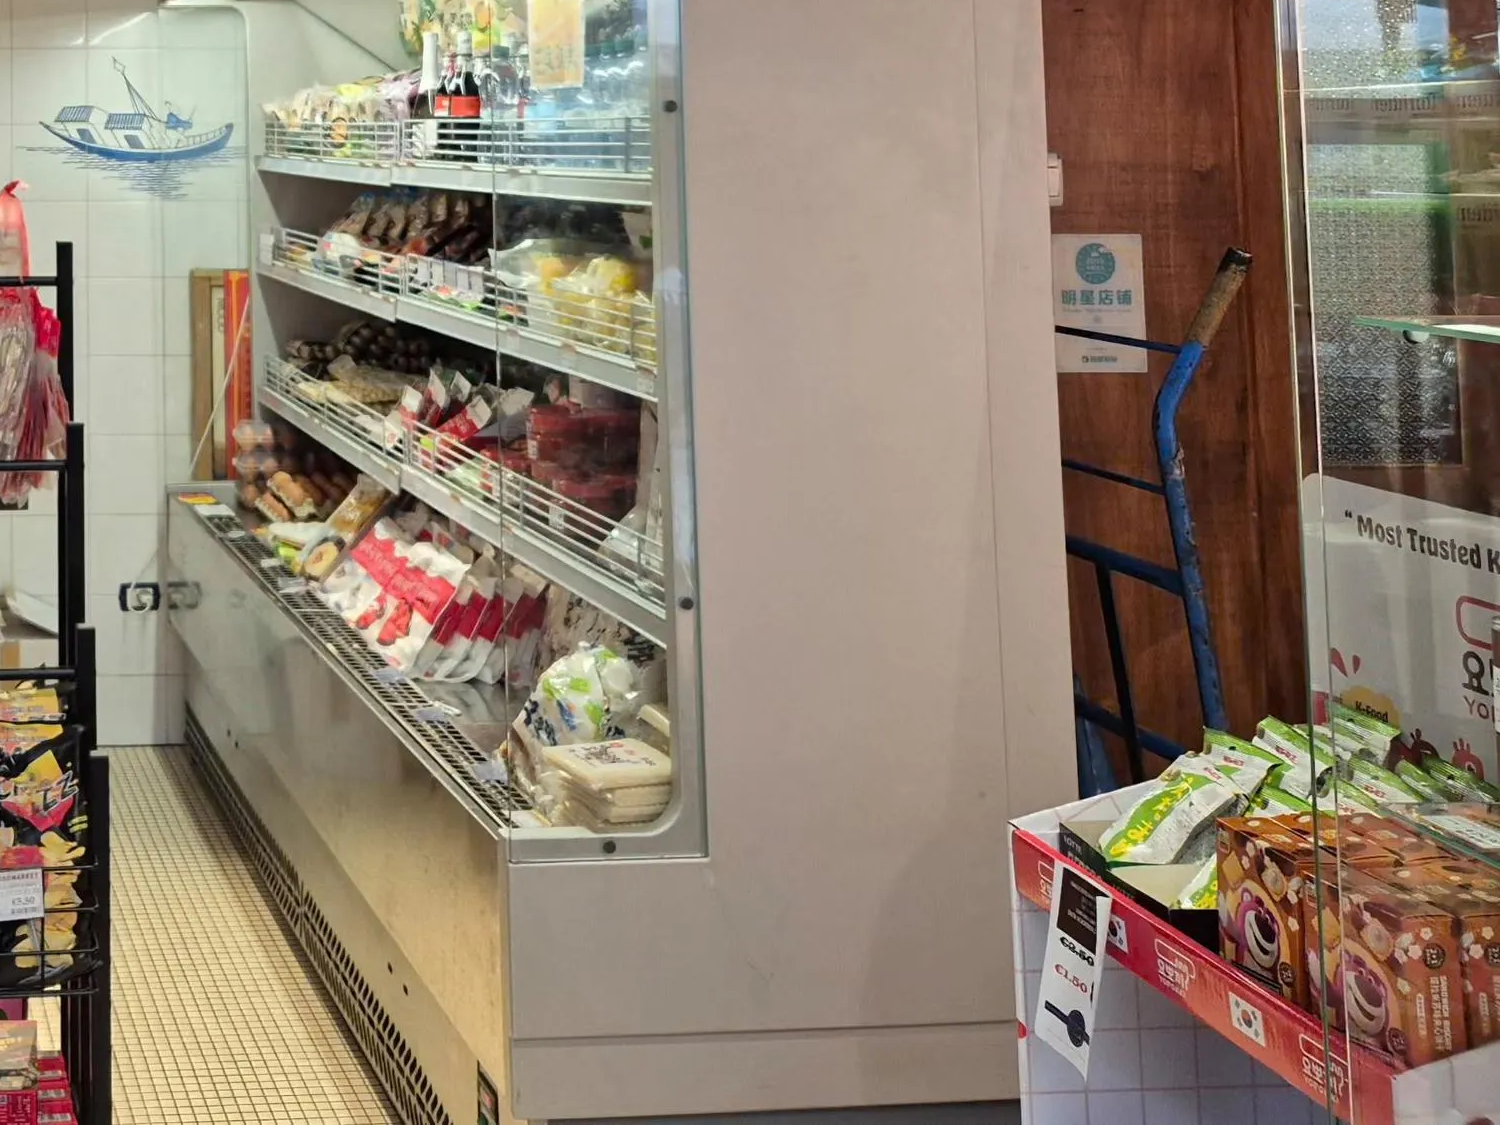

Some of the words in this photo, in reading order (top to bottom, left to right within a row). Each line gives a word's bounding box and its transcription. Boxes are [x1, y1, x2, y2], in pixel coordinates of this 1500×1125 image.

[1061, 289, 1132, 307] 明星店铺
[1407, 527, 1482, 570] Trusted
[1463, 695, 1495, 724] YO
[1054, 963, 1088, 994] €1.50
